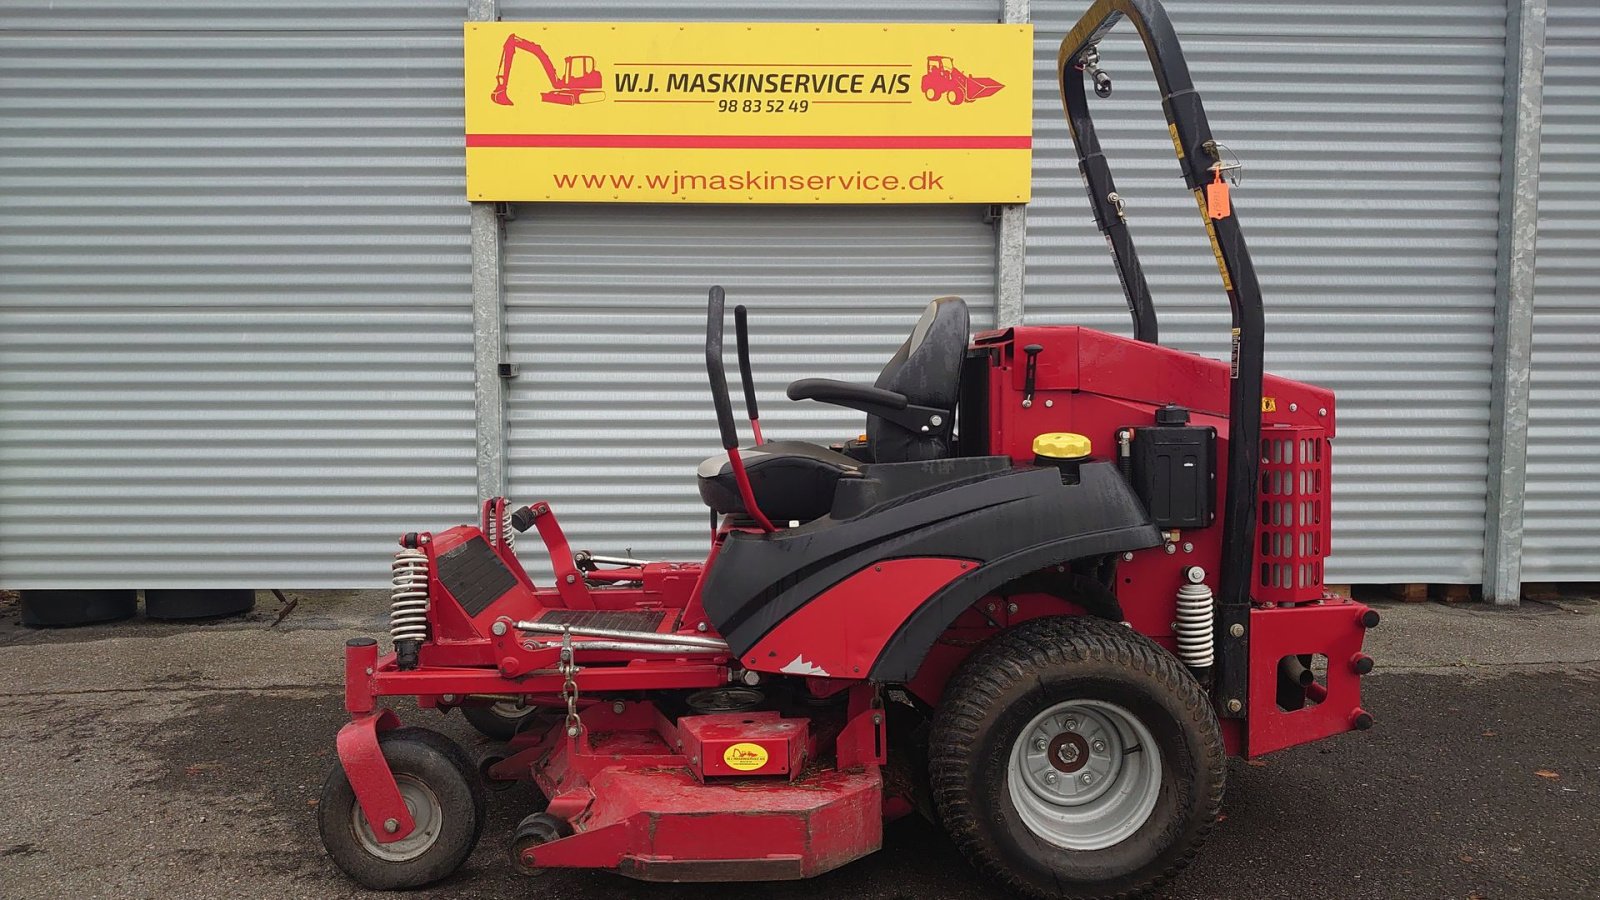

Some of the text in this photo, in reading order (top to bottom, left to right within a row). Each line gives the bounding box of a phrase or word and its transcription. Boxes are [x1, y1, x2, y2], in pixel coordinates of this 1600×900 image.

[615, 73, 911, 95] W.J. MASKINSERVICE A/S
[718, 99, 809, 113] 98 83 52 49
[553, 170, 944, 194] www.wjmaskinservice.dk
